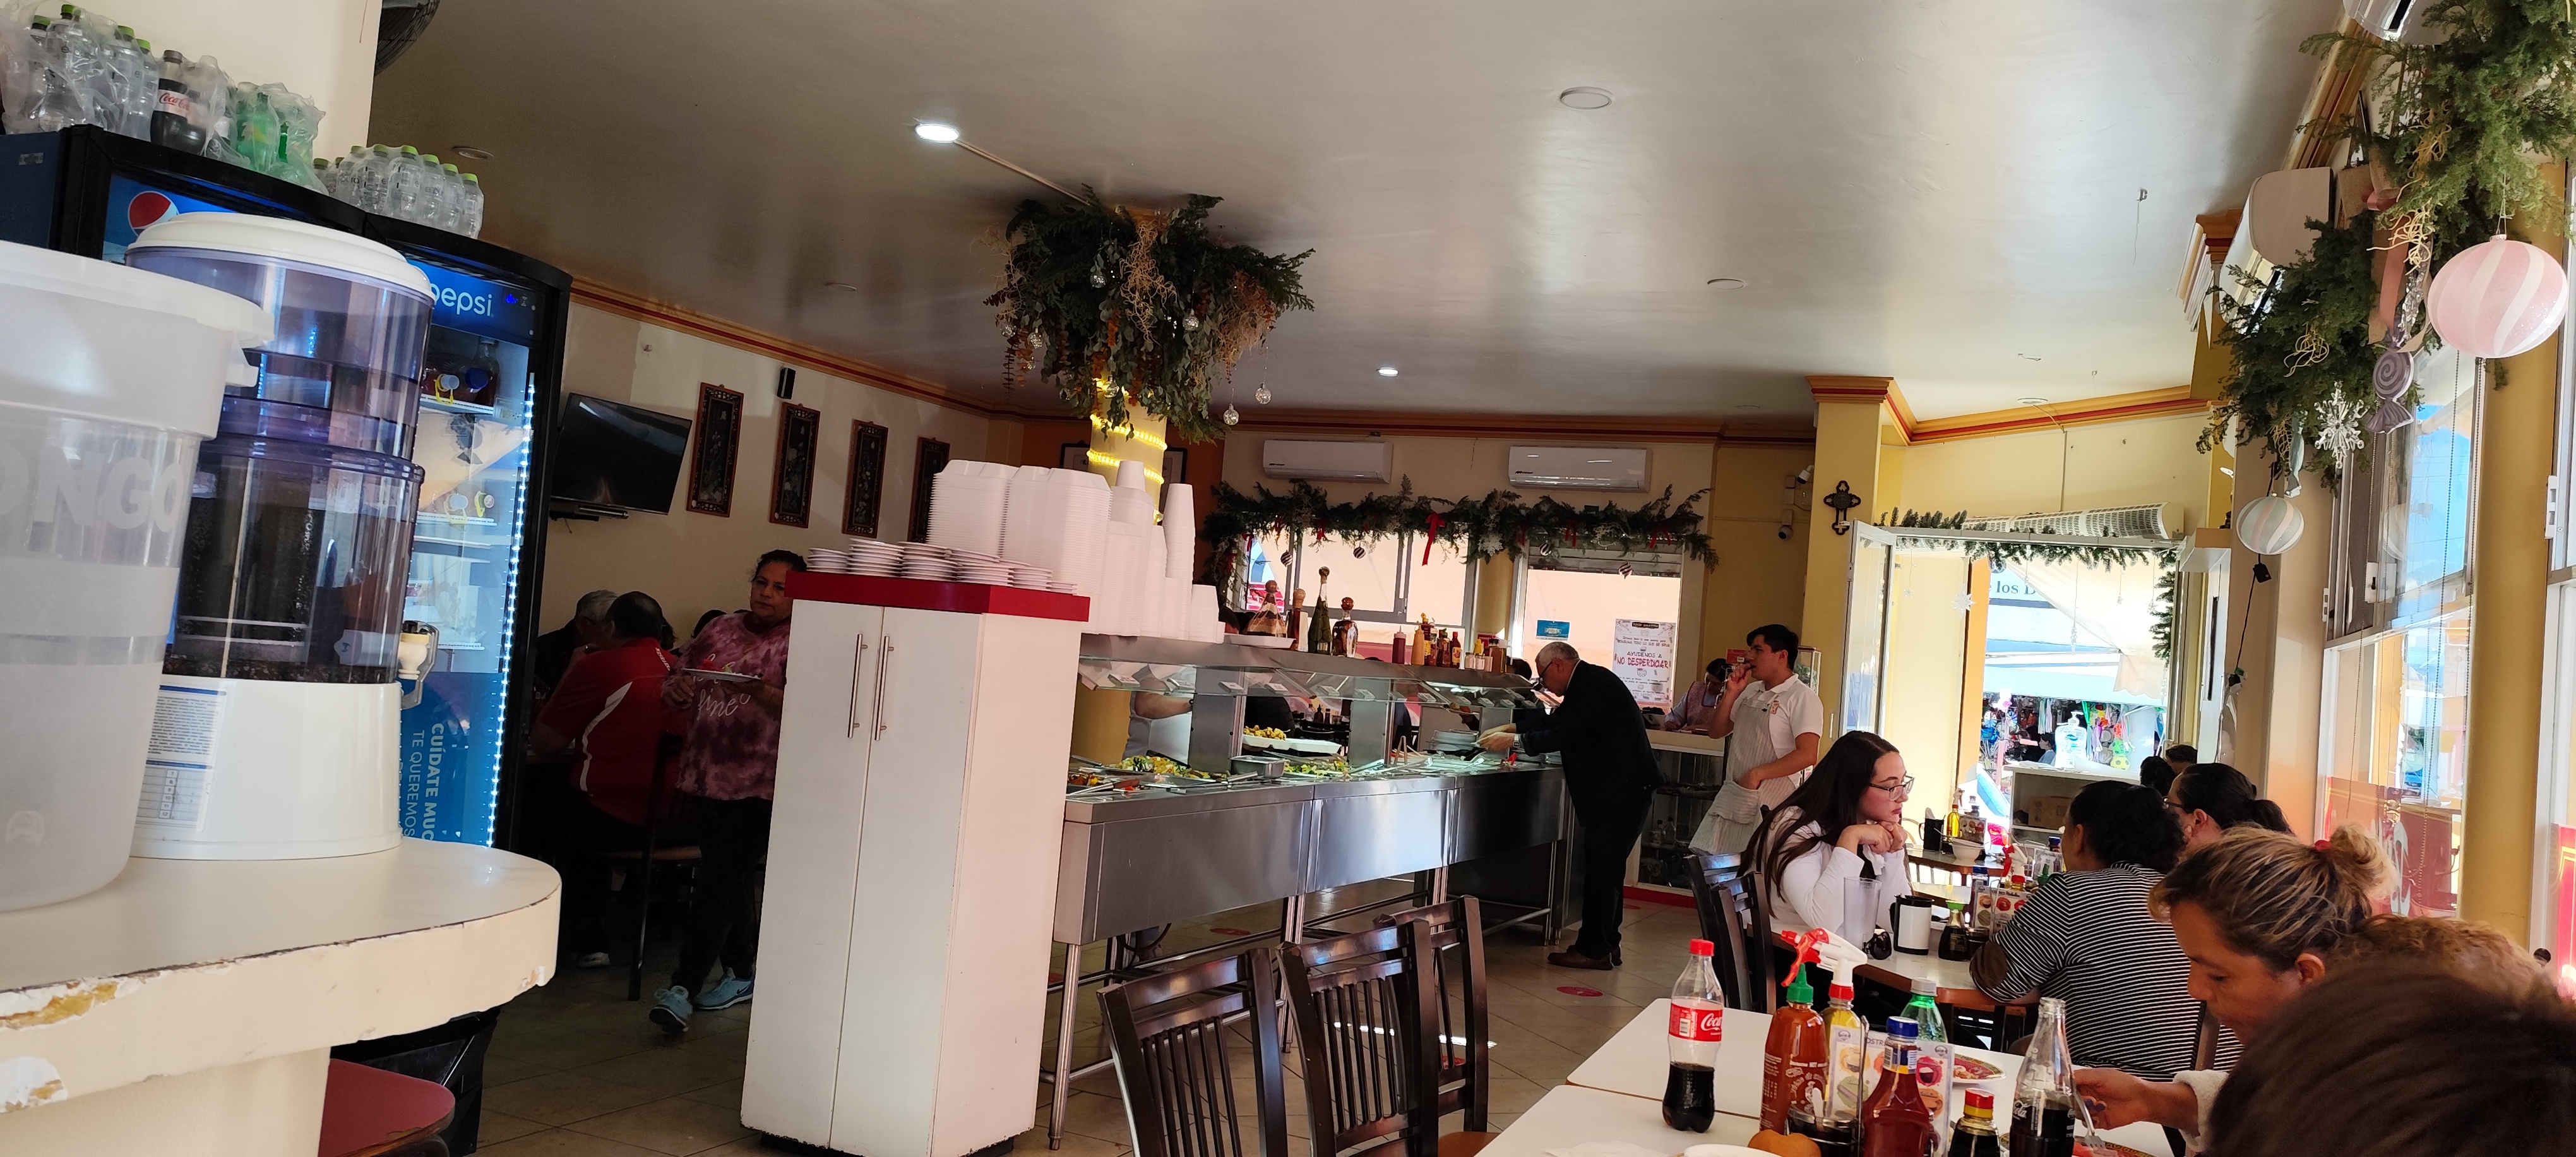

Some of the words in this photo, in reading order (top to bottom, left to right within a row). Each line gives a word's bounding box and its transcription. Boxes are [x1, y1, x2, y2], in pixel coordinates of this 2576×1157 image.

[1996, 580, 2018, 594] los
[1617, 656, 1625, 665] NO
[412, 730, 425, 748] TE
[426, 723, 446, 798] CUÍDATE
[403, 752, 422, 837] QUEREMOS
